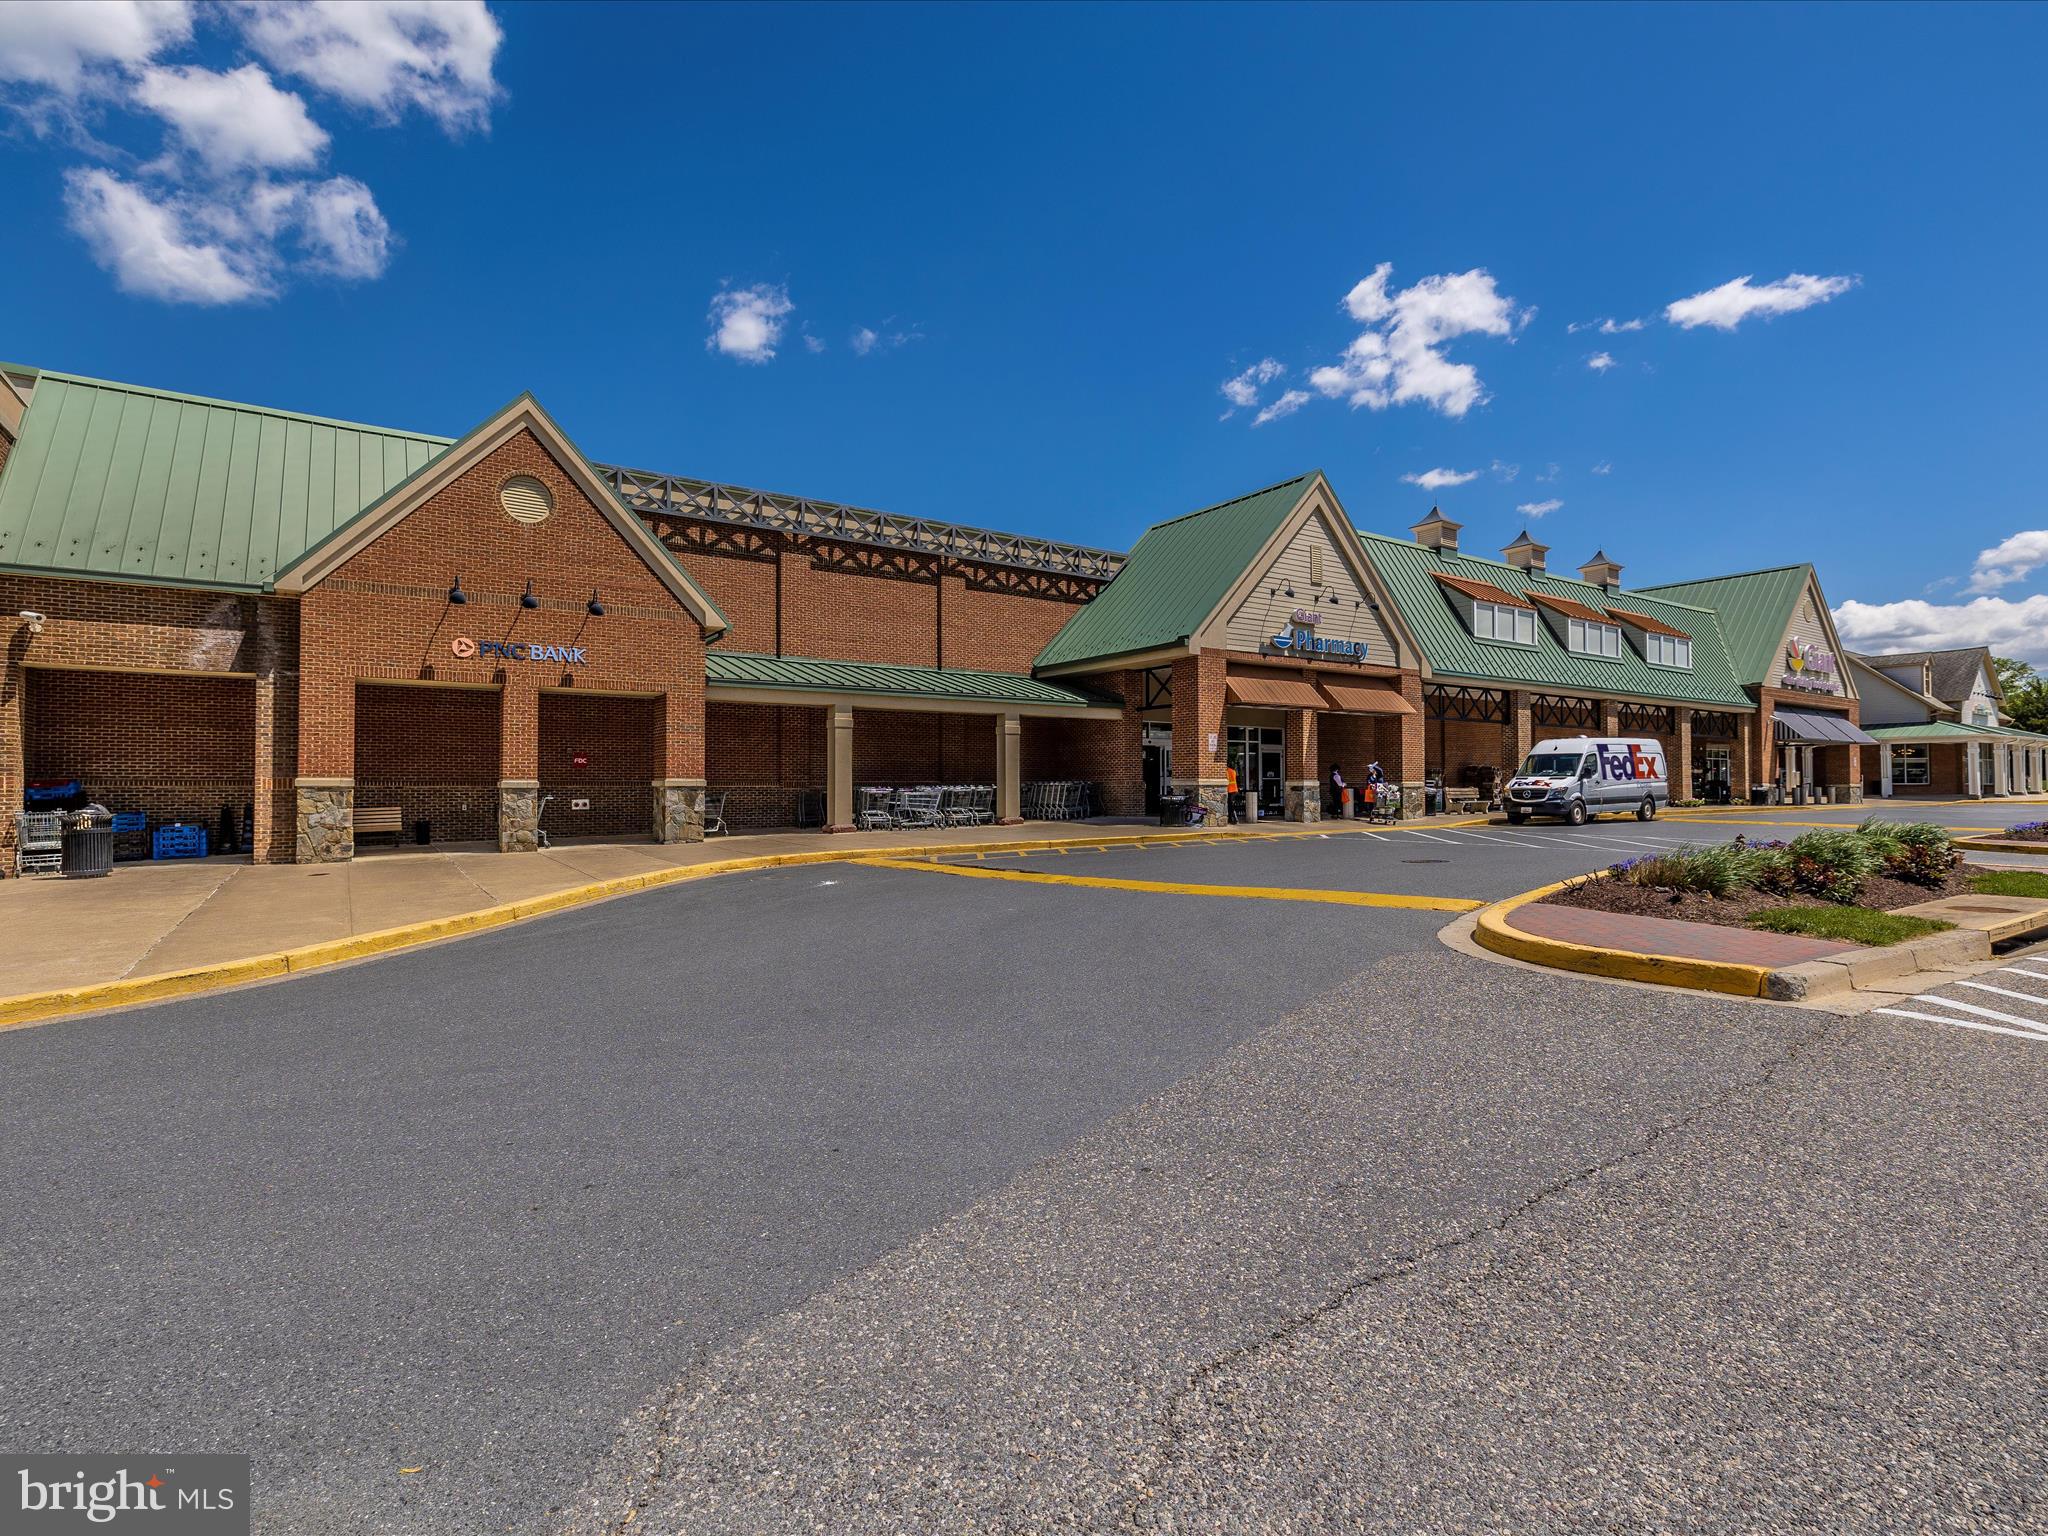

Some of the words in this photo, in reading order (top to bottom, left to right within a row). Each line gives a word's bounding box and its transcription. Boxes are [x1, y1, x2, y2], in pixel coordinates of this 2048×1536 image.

[1296, 608, 1322, 624] Giant
[479, 640, 526, 660] PNC
[529, 644, 587, 663] BANK
[1296, 630, 1369, 660] Pharmacy
[1595, 743, 1660, 781] FedEx
[1511, 780, 1552, 788] FedEx
